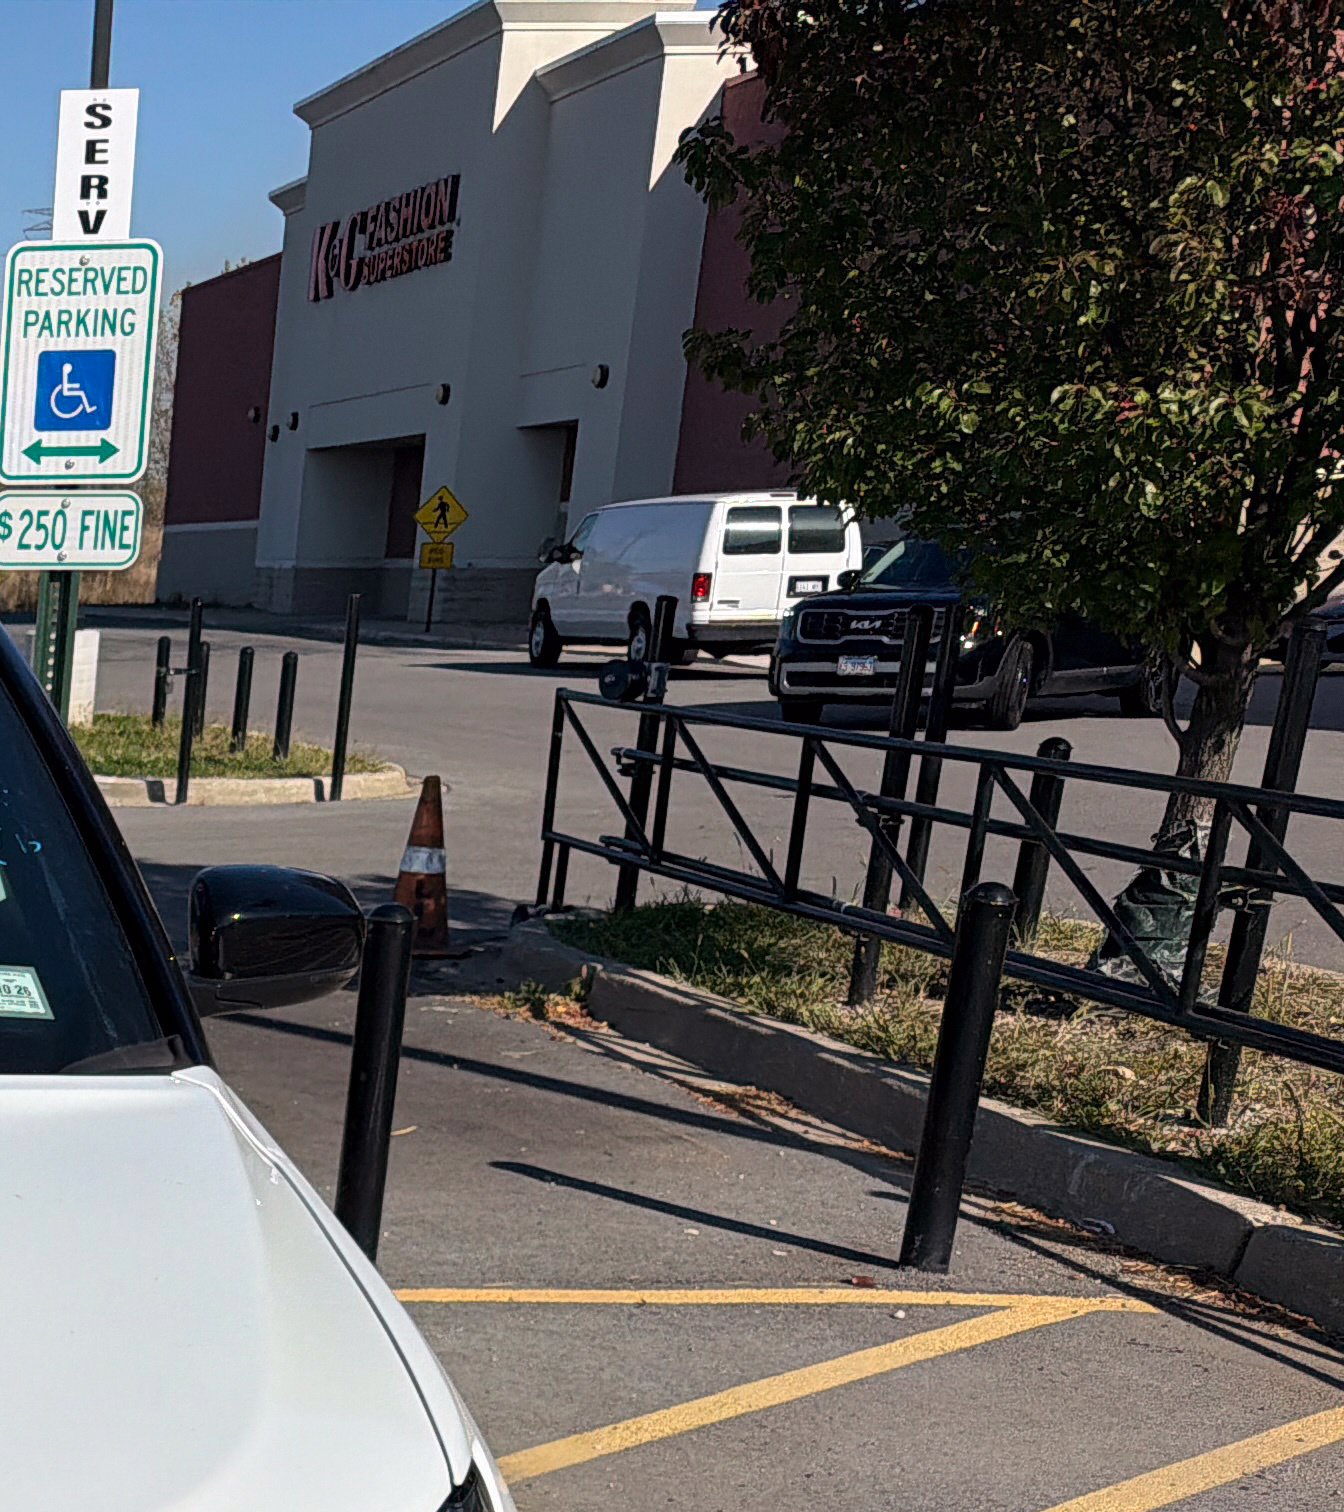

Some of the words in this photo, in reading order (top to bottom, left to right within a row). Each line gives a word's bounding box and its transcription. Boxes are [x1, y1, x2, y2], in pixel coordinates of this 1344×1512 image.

[76, 102, 113, 236] SERV
[366, 175, 459, 250] FASHION
[16, 265, 148, 298] RESERVED
[308, 212, 366, 302] K&G
[361, 230, 454, 285] SUPERSTORE
[22, 307, 137, 339] PARKING
[78, 509, 135, 551] FINE
